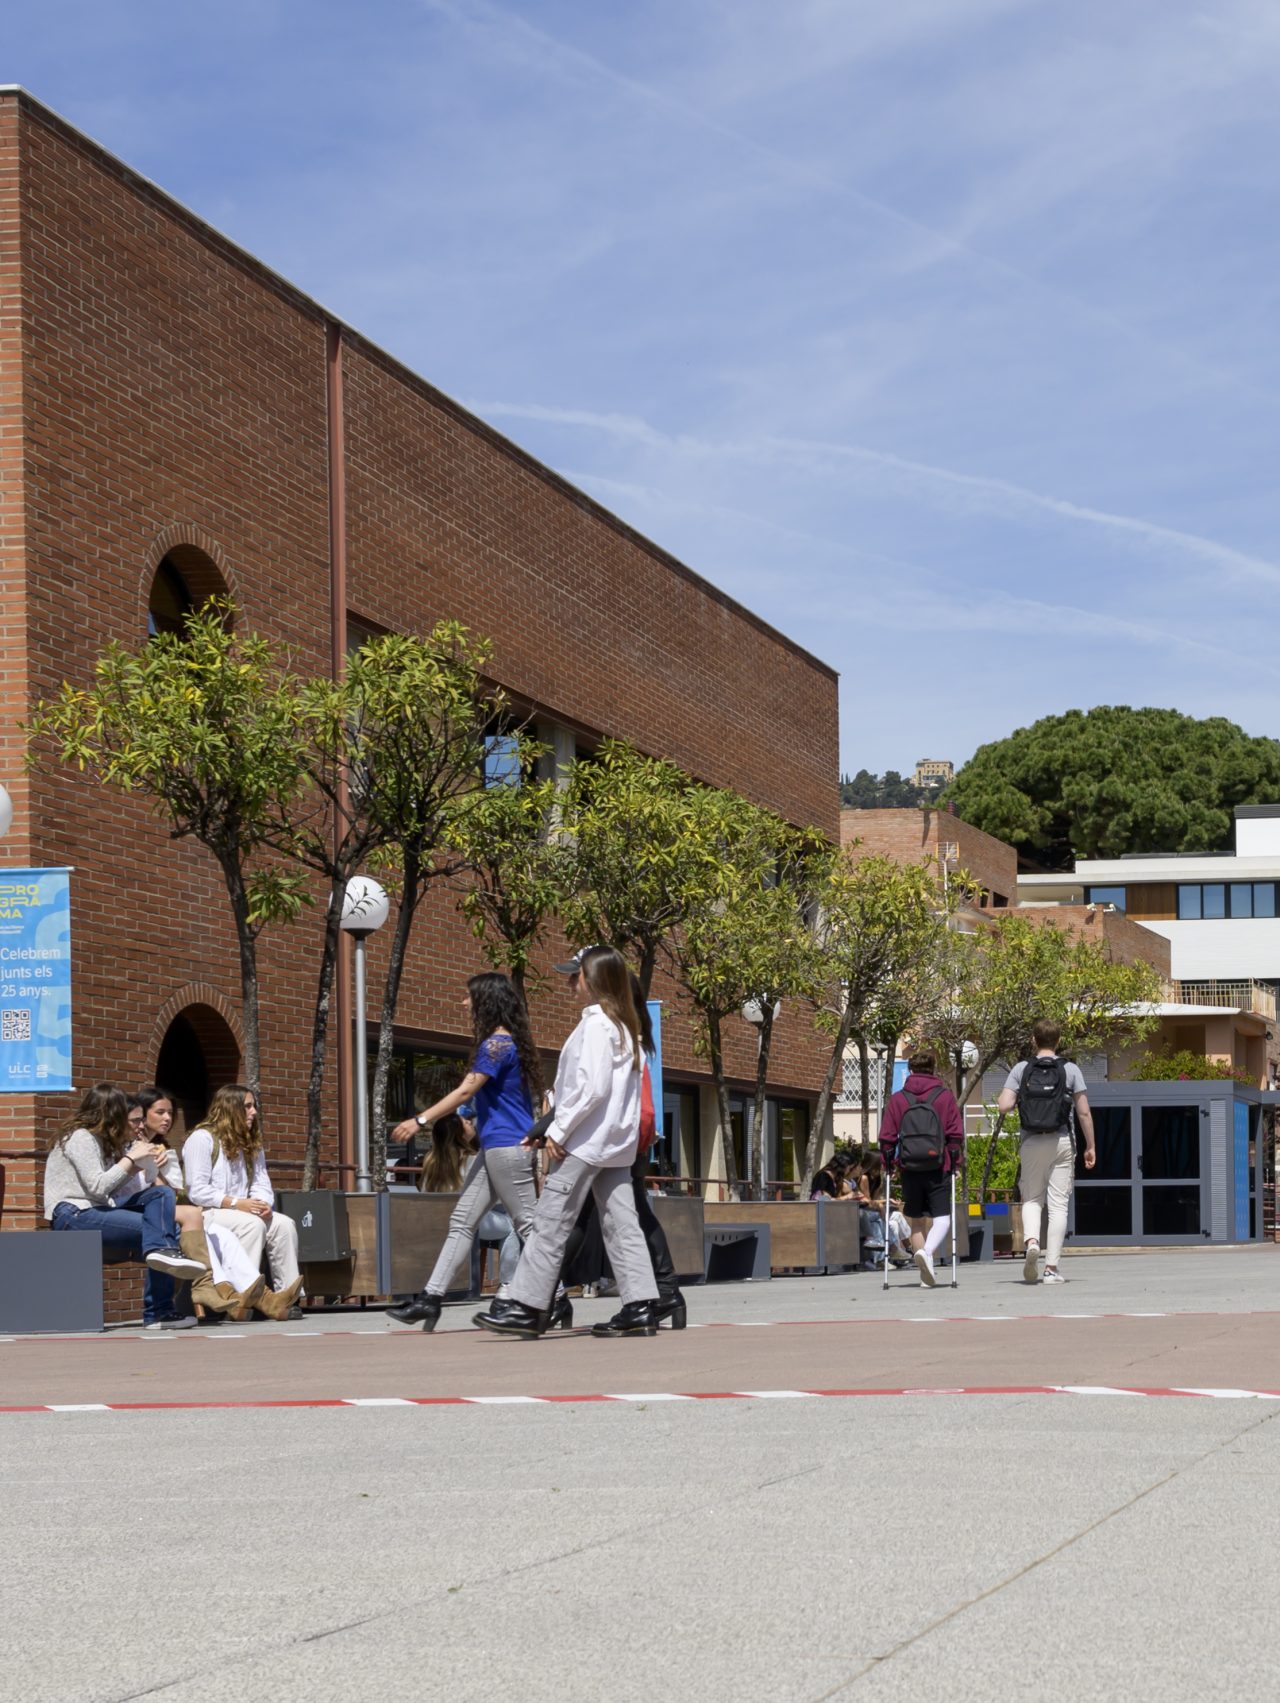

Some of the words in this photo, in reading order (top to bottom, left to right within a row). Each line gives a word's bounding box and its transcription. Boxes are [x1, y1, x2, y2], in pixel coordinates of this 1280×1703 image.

[0, 947, 61, 960] Celebrem
[0, 966, 32, 981] junts
[34, 965, 53, 978] els
[1, 985, 16, 998] 25
[19, 986, 52, 1000] anys.
